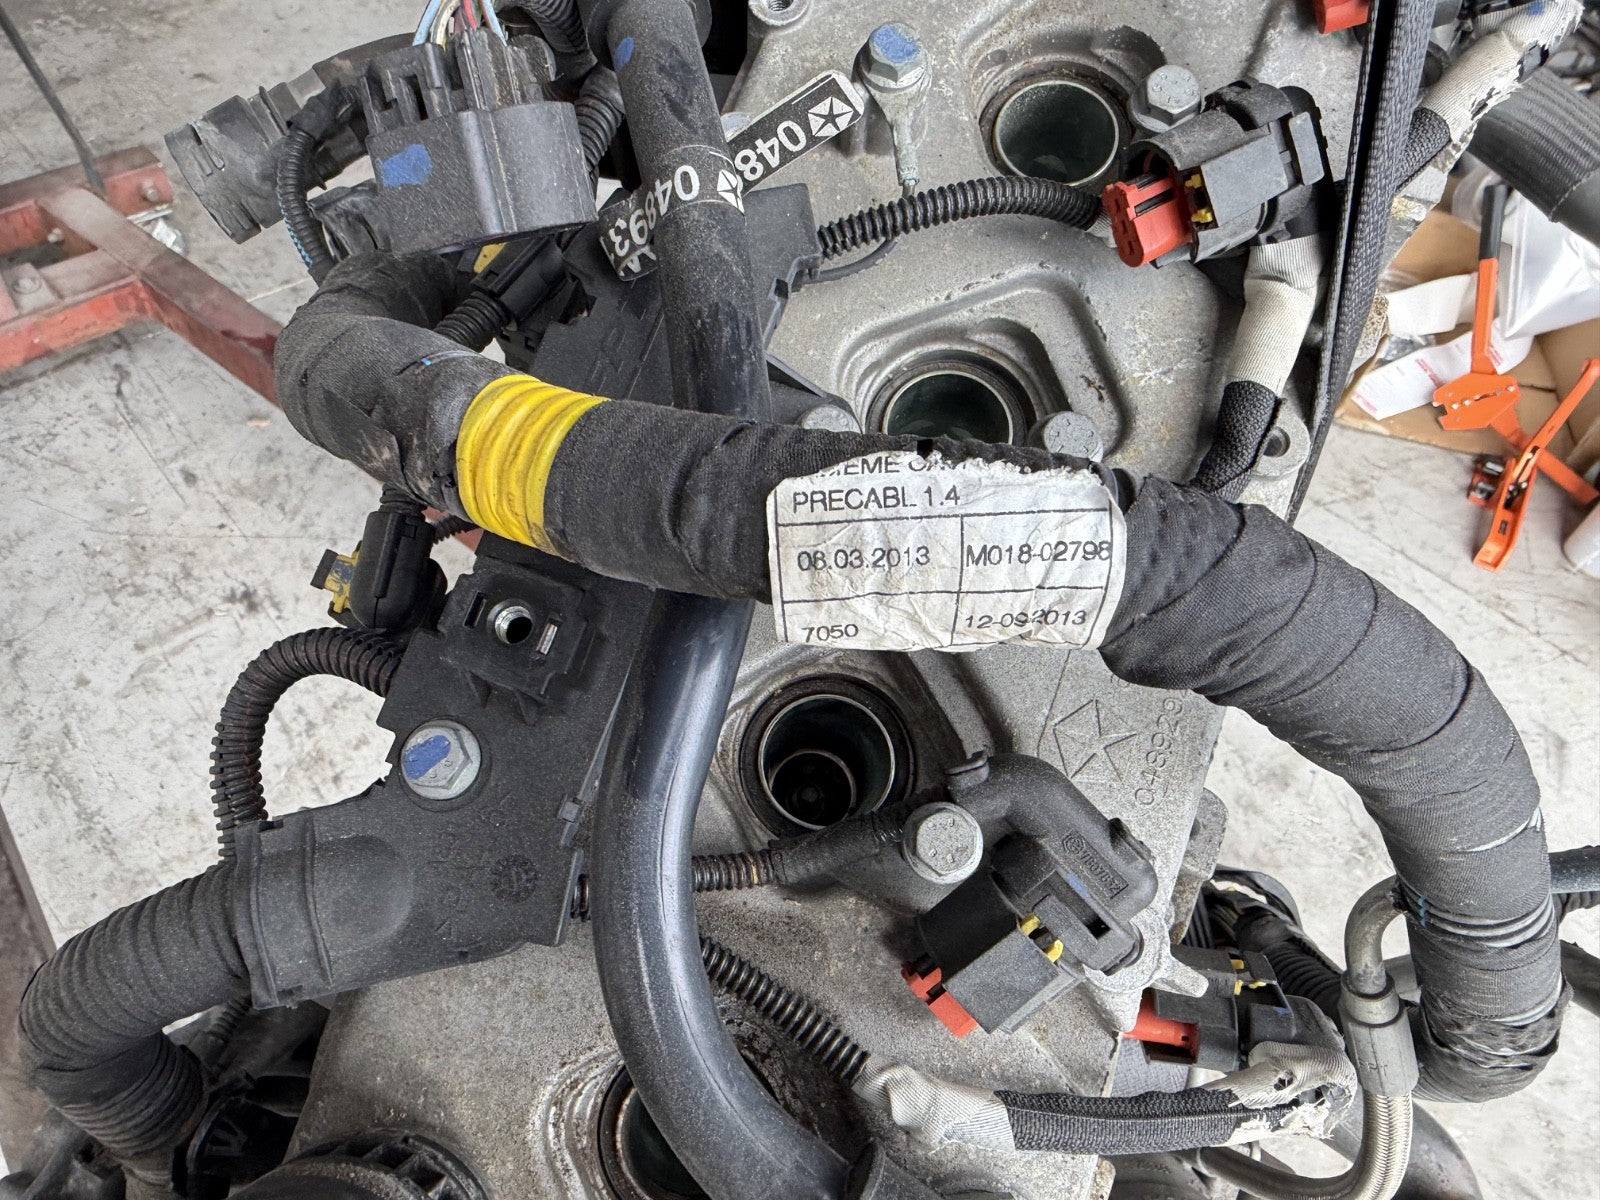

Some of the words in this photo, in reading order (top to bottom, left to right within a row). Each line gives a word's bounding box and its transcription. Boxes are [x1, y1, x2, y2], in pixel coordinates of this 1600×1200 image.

[793, 486, 917, 514] PRECABL
[924, 484, 961, 507] 1.4
[965, 541, 1112, 567] M018-02798
[802, 623, 860, 642] 7050
